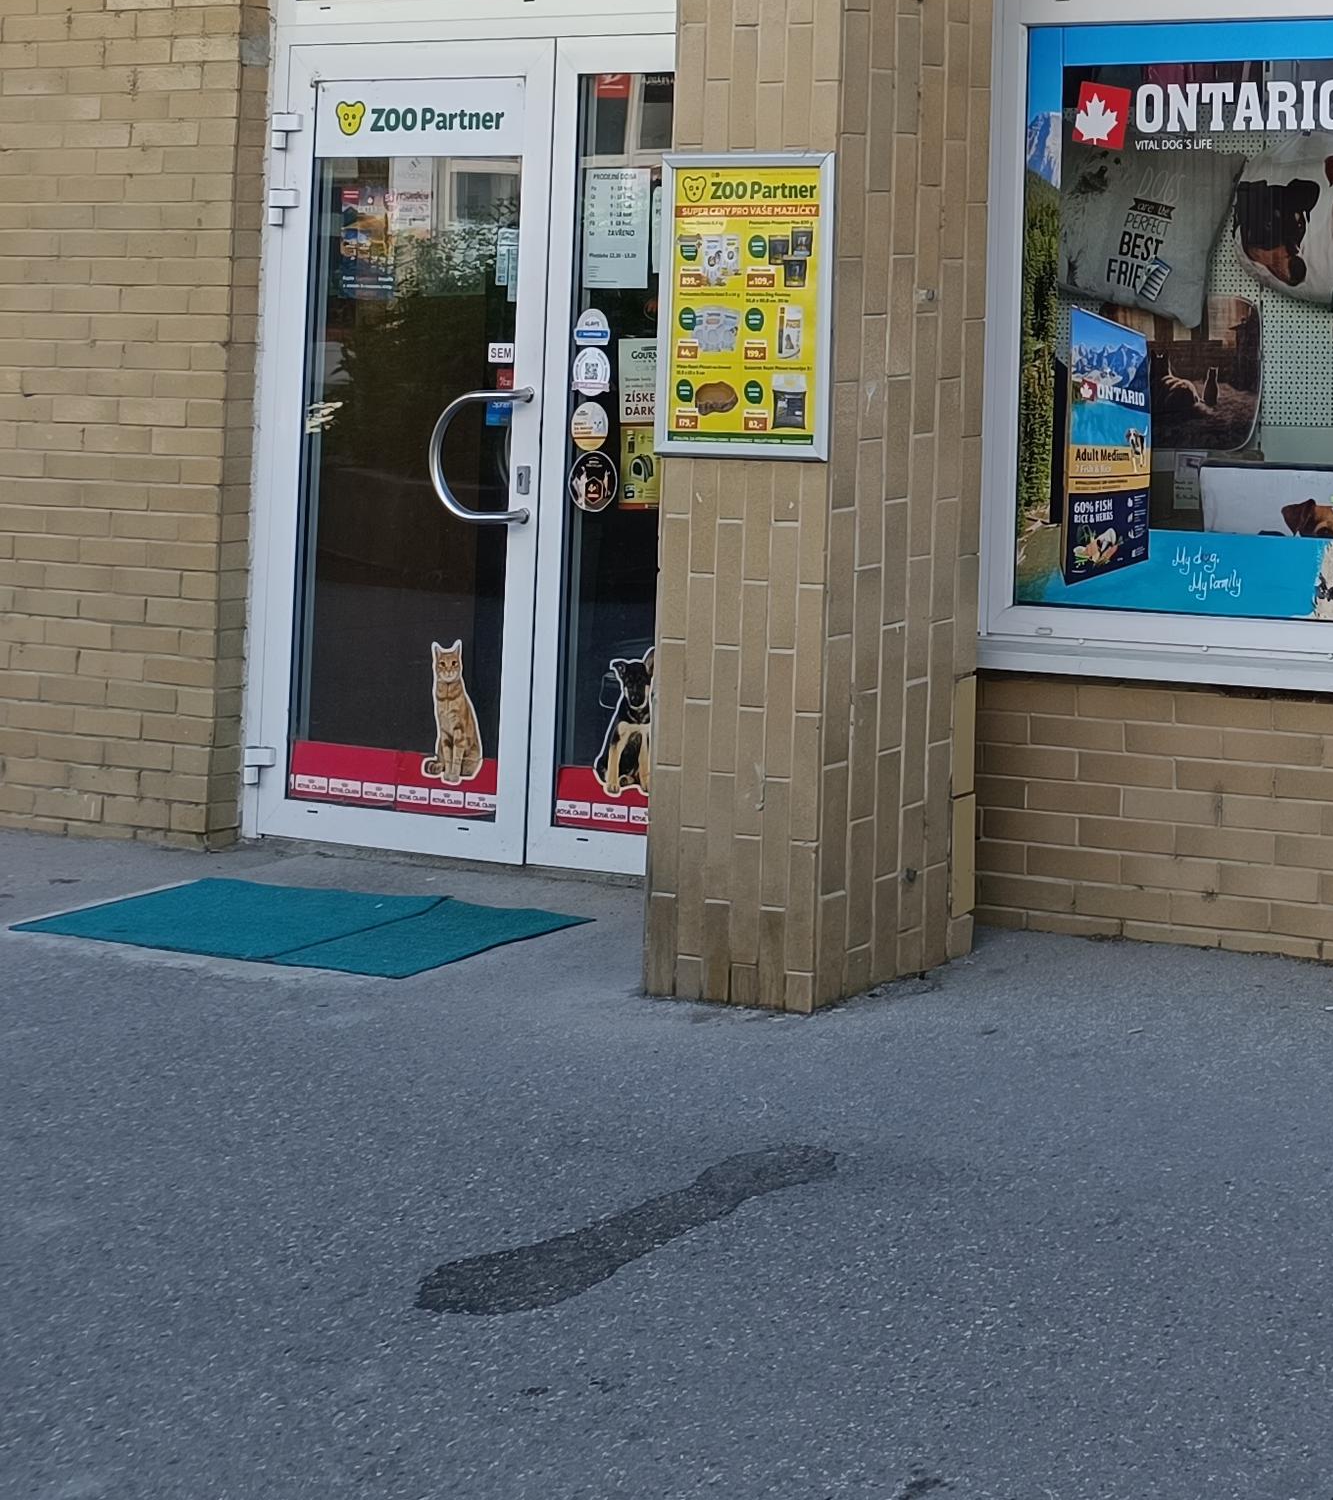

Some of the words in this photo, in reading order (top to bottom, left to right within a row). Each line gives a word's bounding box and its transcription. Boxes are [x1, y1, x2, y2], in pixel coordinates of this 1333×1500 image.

[370, 107, 418, 132] ZOO
[421, 107, 505, 132] Partner
[1135, 140, 1160, 151] VITAL
[1194, 139, 1213, 150] LIFE
[710, 181, 748, 200] ZOO
[750, 181, 817, 200] Partner
[682, 206, 708, 216] SUPER
[731, 206, 749, 216] PRO
[750, 204, 772, 216] VAŠE
[1124, 212, 1170, 236] PERFECT
[1118, 230, 1163, 262] BEST
[1096, 384, 1145, 407] ONTARIO
[625, 404, 655, 417] DÁRK
[1075, 448, 1099, 461] Adult
[1101, 449, 1130, 461] Medium
[1074, 500, 1094, 514] 60%
[1095, 499, 1113, 512] FISH
[1074, 514, 1089, 524] RICE
[1172, 546, 1191, 575] My
[1189, 572, 1207, 601] My
[1209, 569, 1242, 598] family
